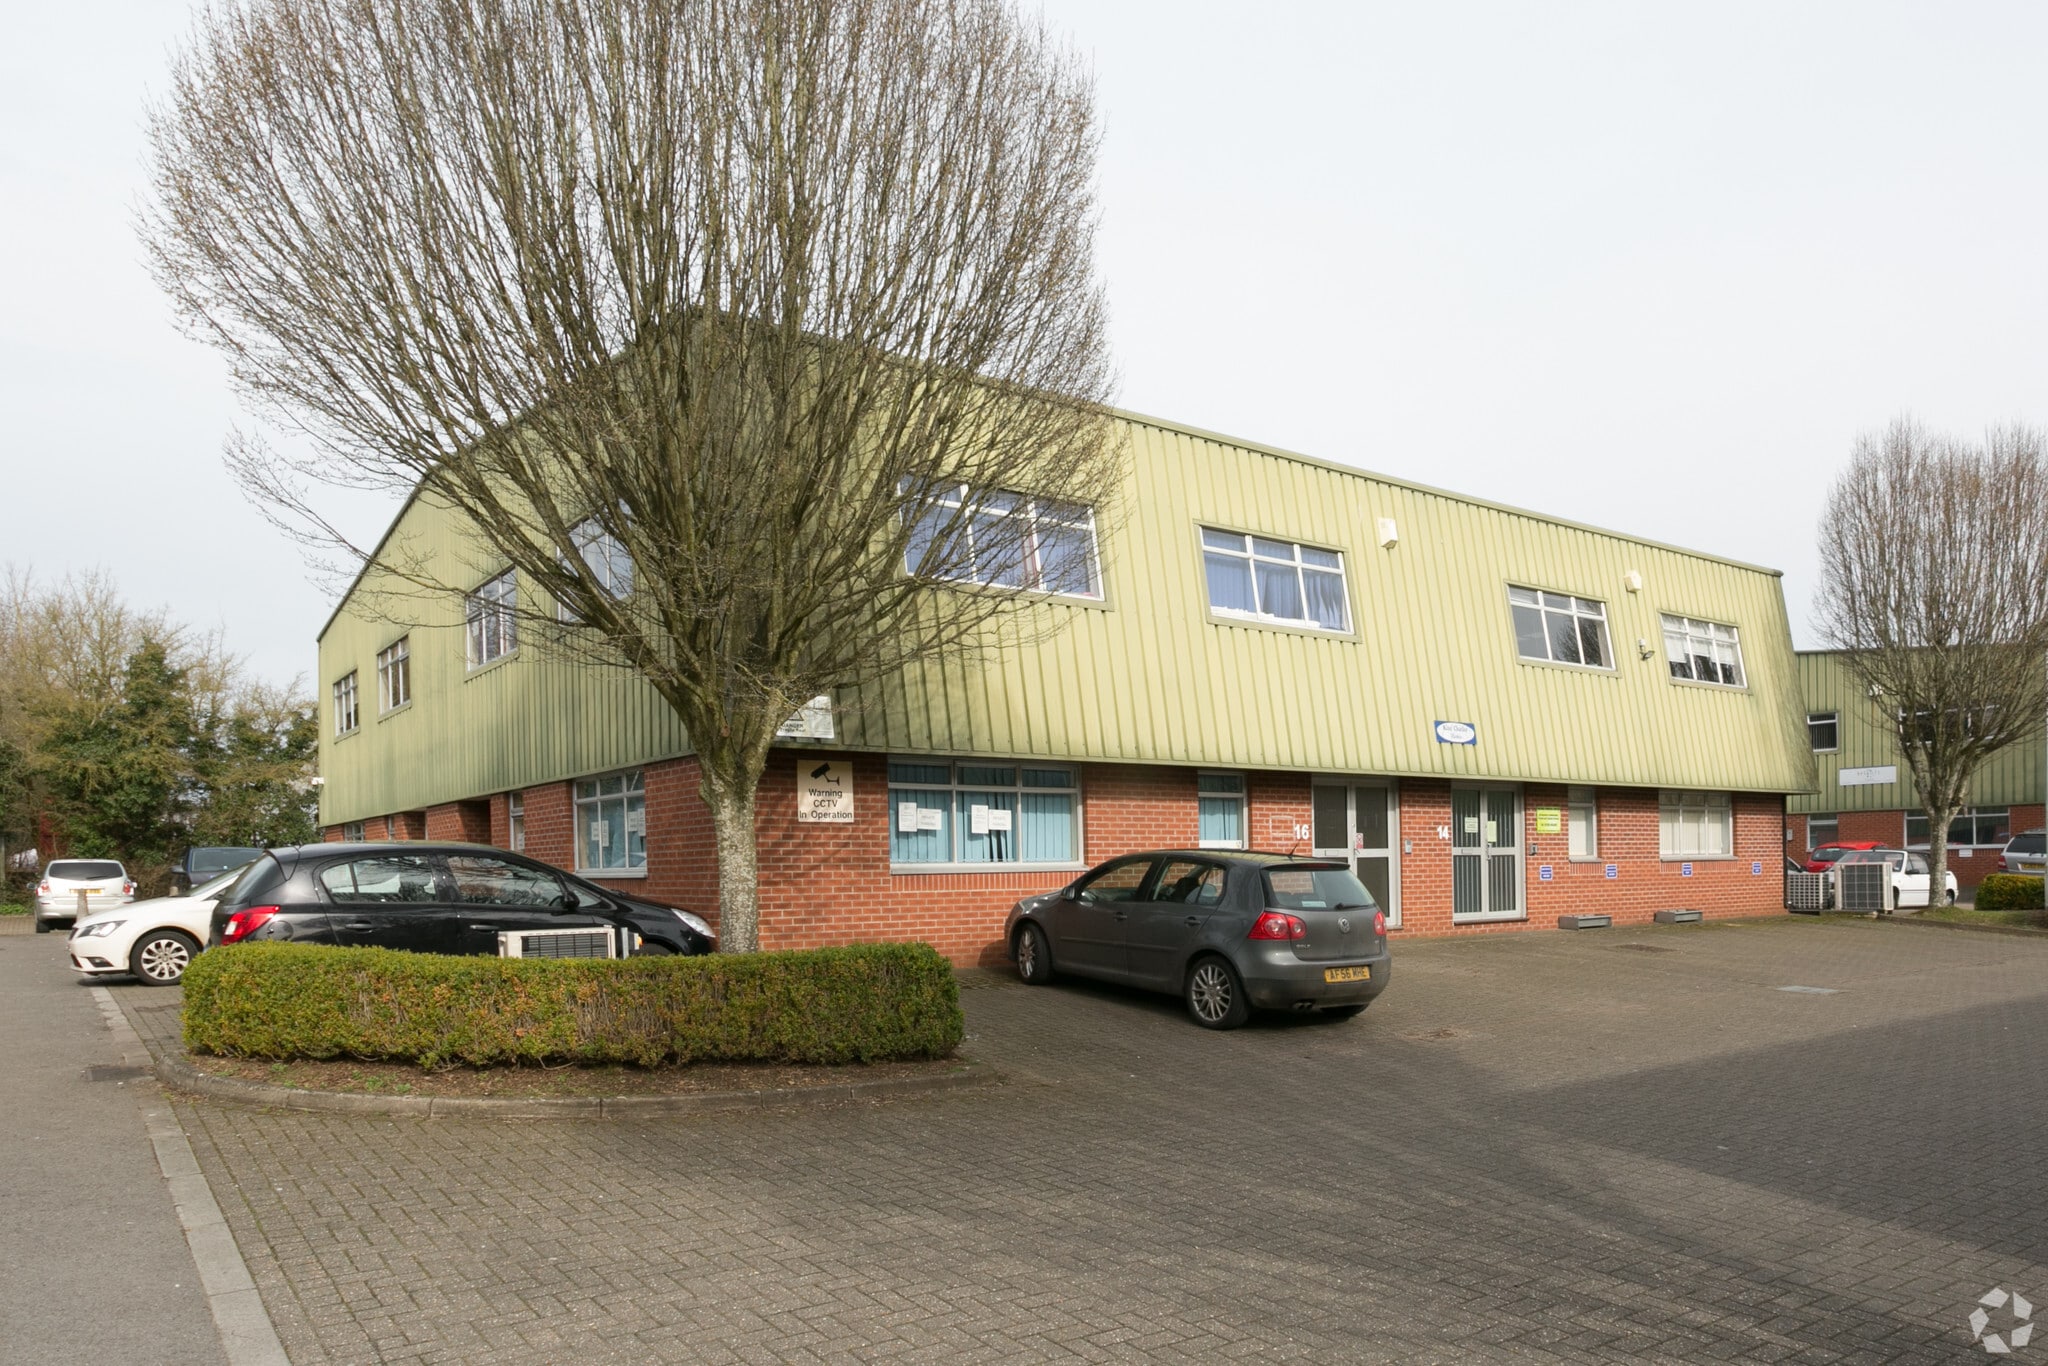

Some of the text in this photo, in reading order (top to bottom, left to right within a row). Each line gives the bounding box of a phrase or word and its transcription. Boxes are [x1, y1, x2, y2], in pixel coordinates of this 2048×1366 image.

[809, 788, 843, 799] Warning
[813, 799, 838, 808] CCTV
[799, 810, 853, 820] In Operation
[1294, 824, 1310, 840] 16
[1436, 825, 1450, 840] 14
[1330, 968, 1352, 980] AF56
